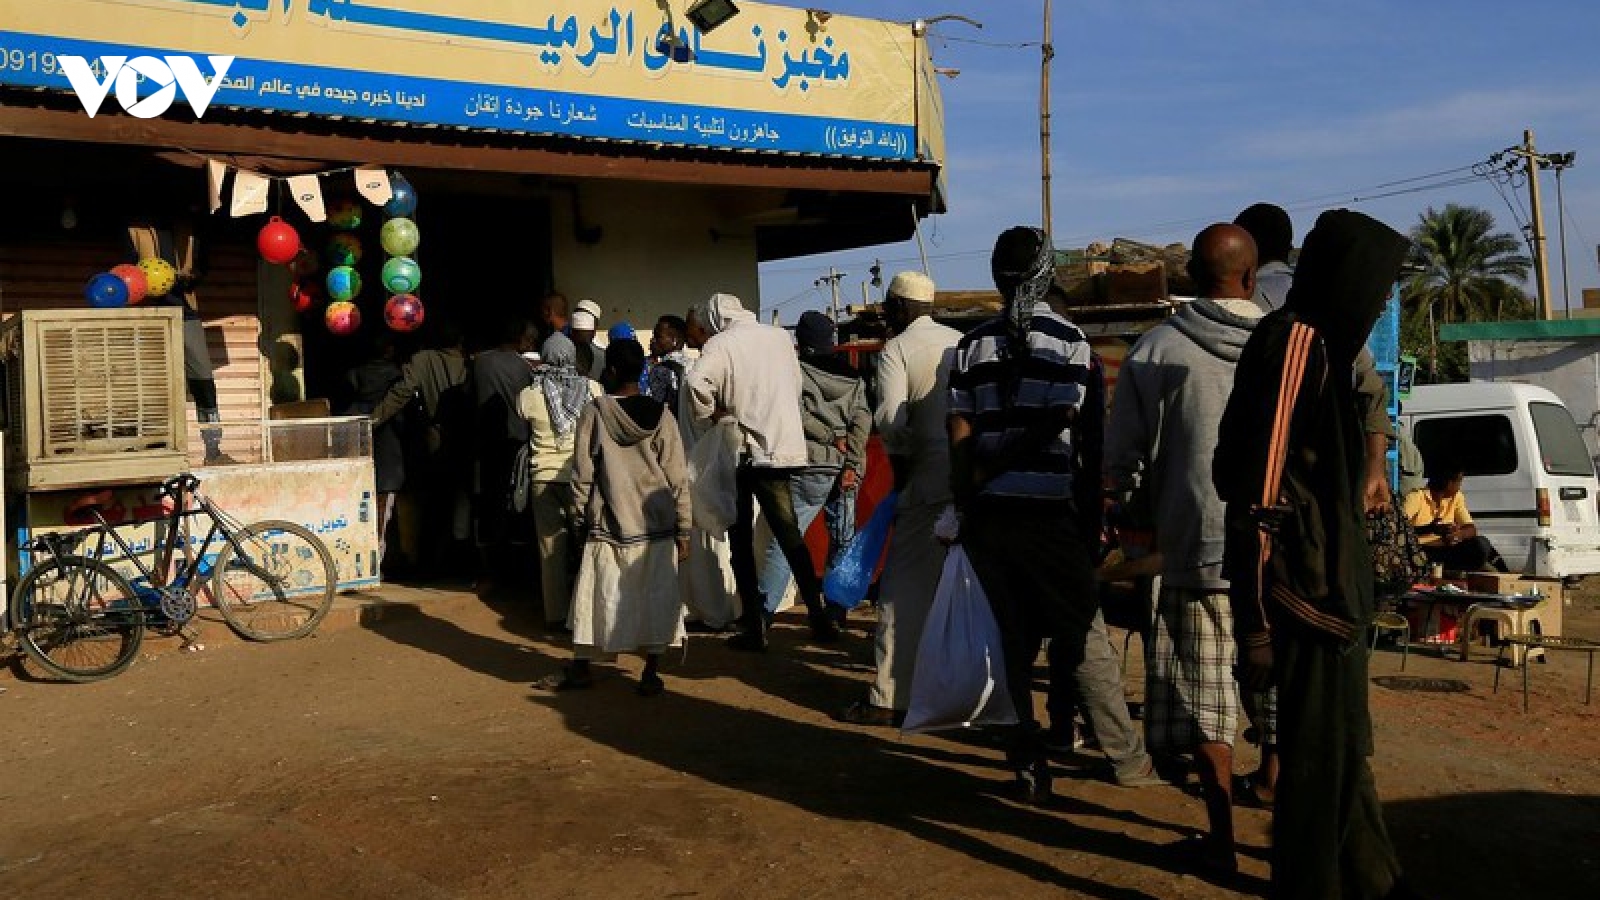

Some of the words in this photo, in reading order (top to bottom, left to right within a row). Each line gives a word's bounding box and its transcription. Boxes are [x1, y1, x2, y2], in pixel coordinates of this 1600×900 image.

[771, 30, 849, 89] مخبز
[258, 77, 293, 96] عالم
[295, 81, 321, 99] في
[395, 90, 426, 111] لدينا
[505, 97, 545, 122] جودة
[549, 99, 597, 125] شعارنا
[626, 111, 690, 133] المناسبات
[728, 121, 781, 143] جاهزون
